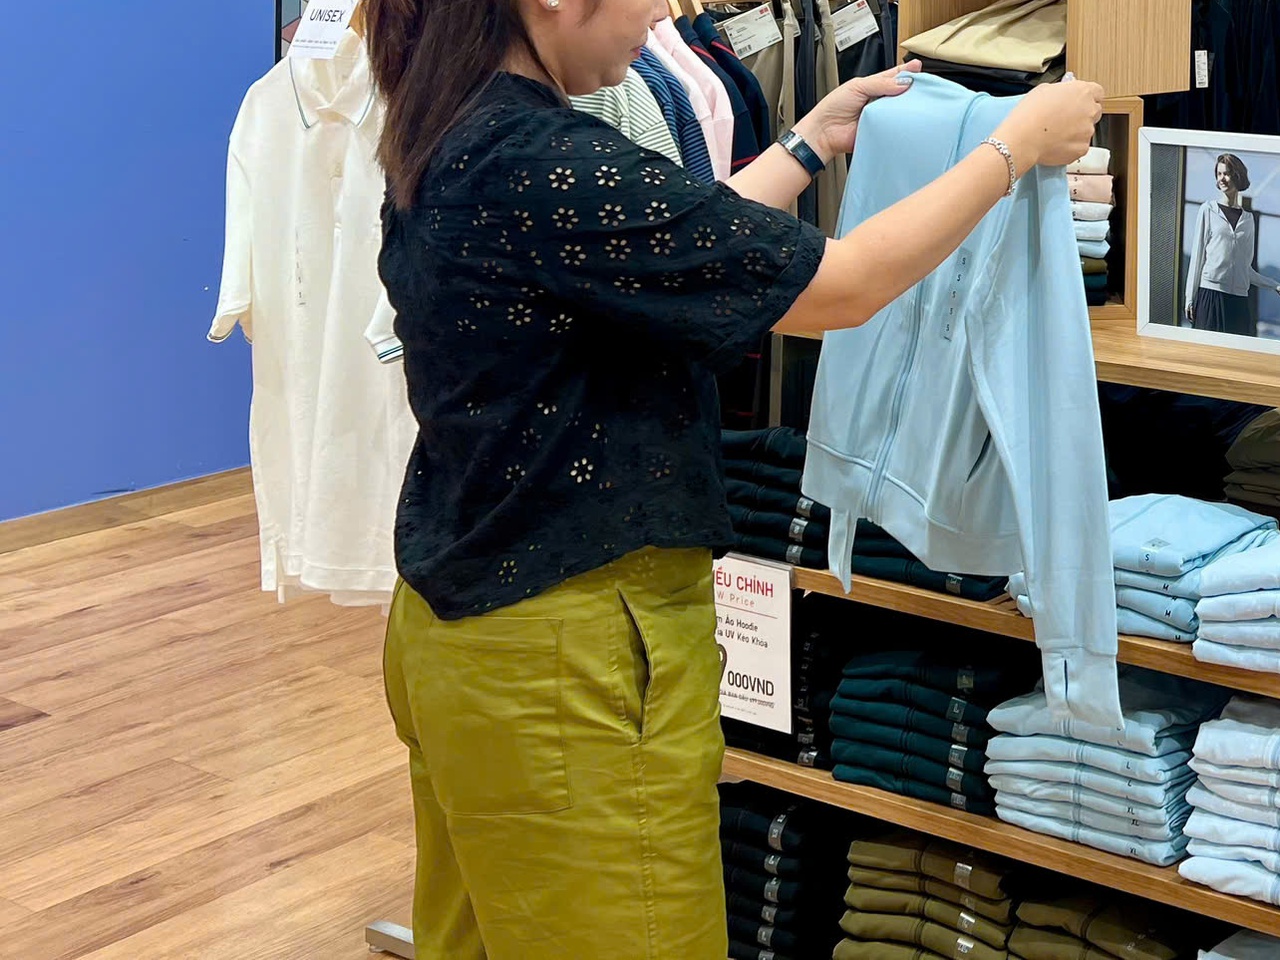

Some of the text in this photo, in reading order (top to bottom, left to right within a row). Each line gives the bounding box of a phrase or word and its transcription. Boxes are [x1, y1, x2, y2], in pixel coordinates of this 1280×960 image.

[309, 9, 345, 22] UNISEX
[729, 593, 755, 607] Price
[736, 619, 758, 632] Hoodie
[725, 629, 735, 639] UV
[727, 670, 774, 696] 000VND
[1126, 761, 1131, 769] L
